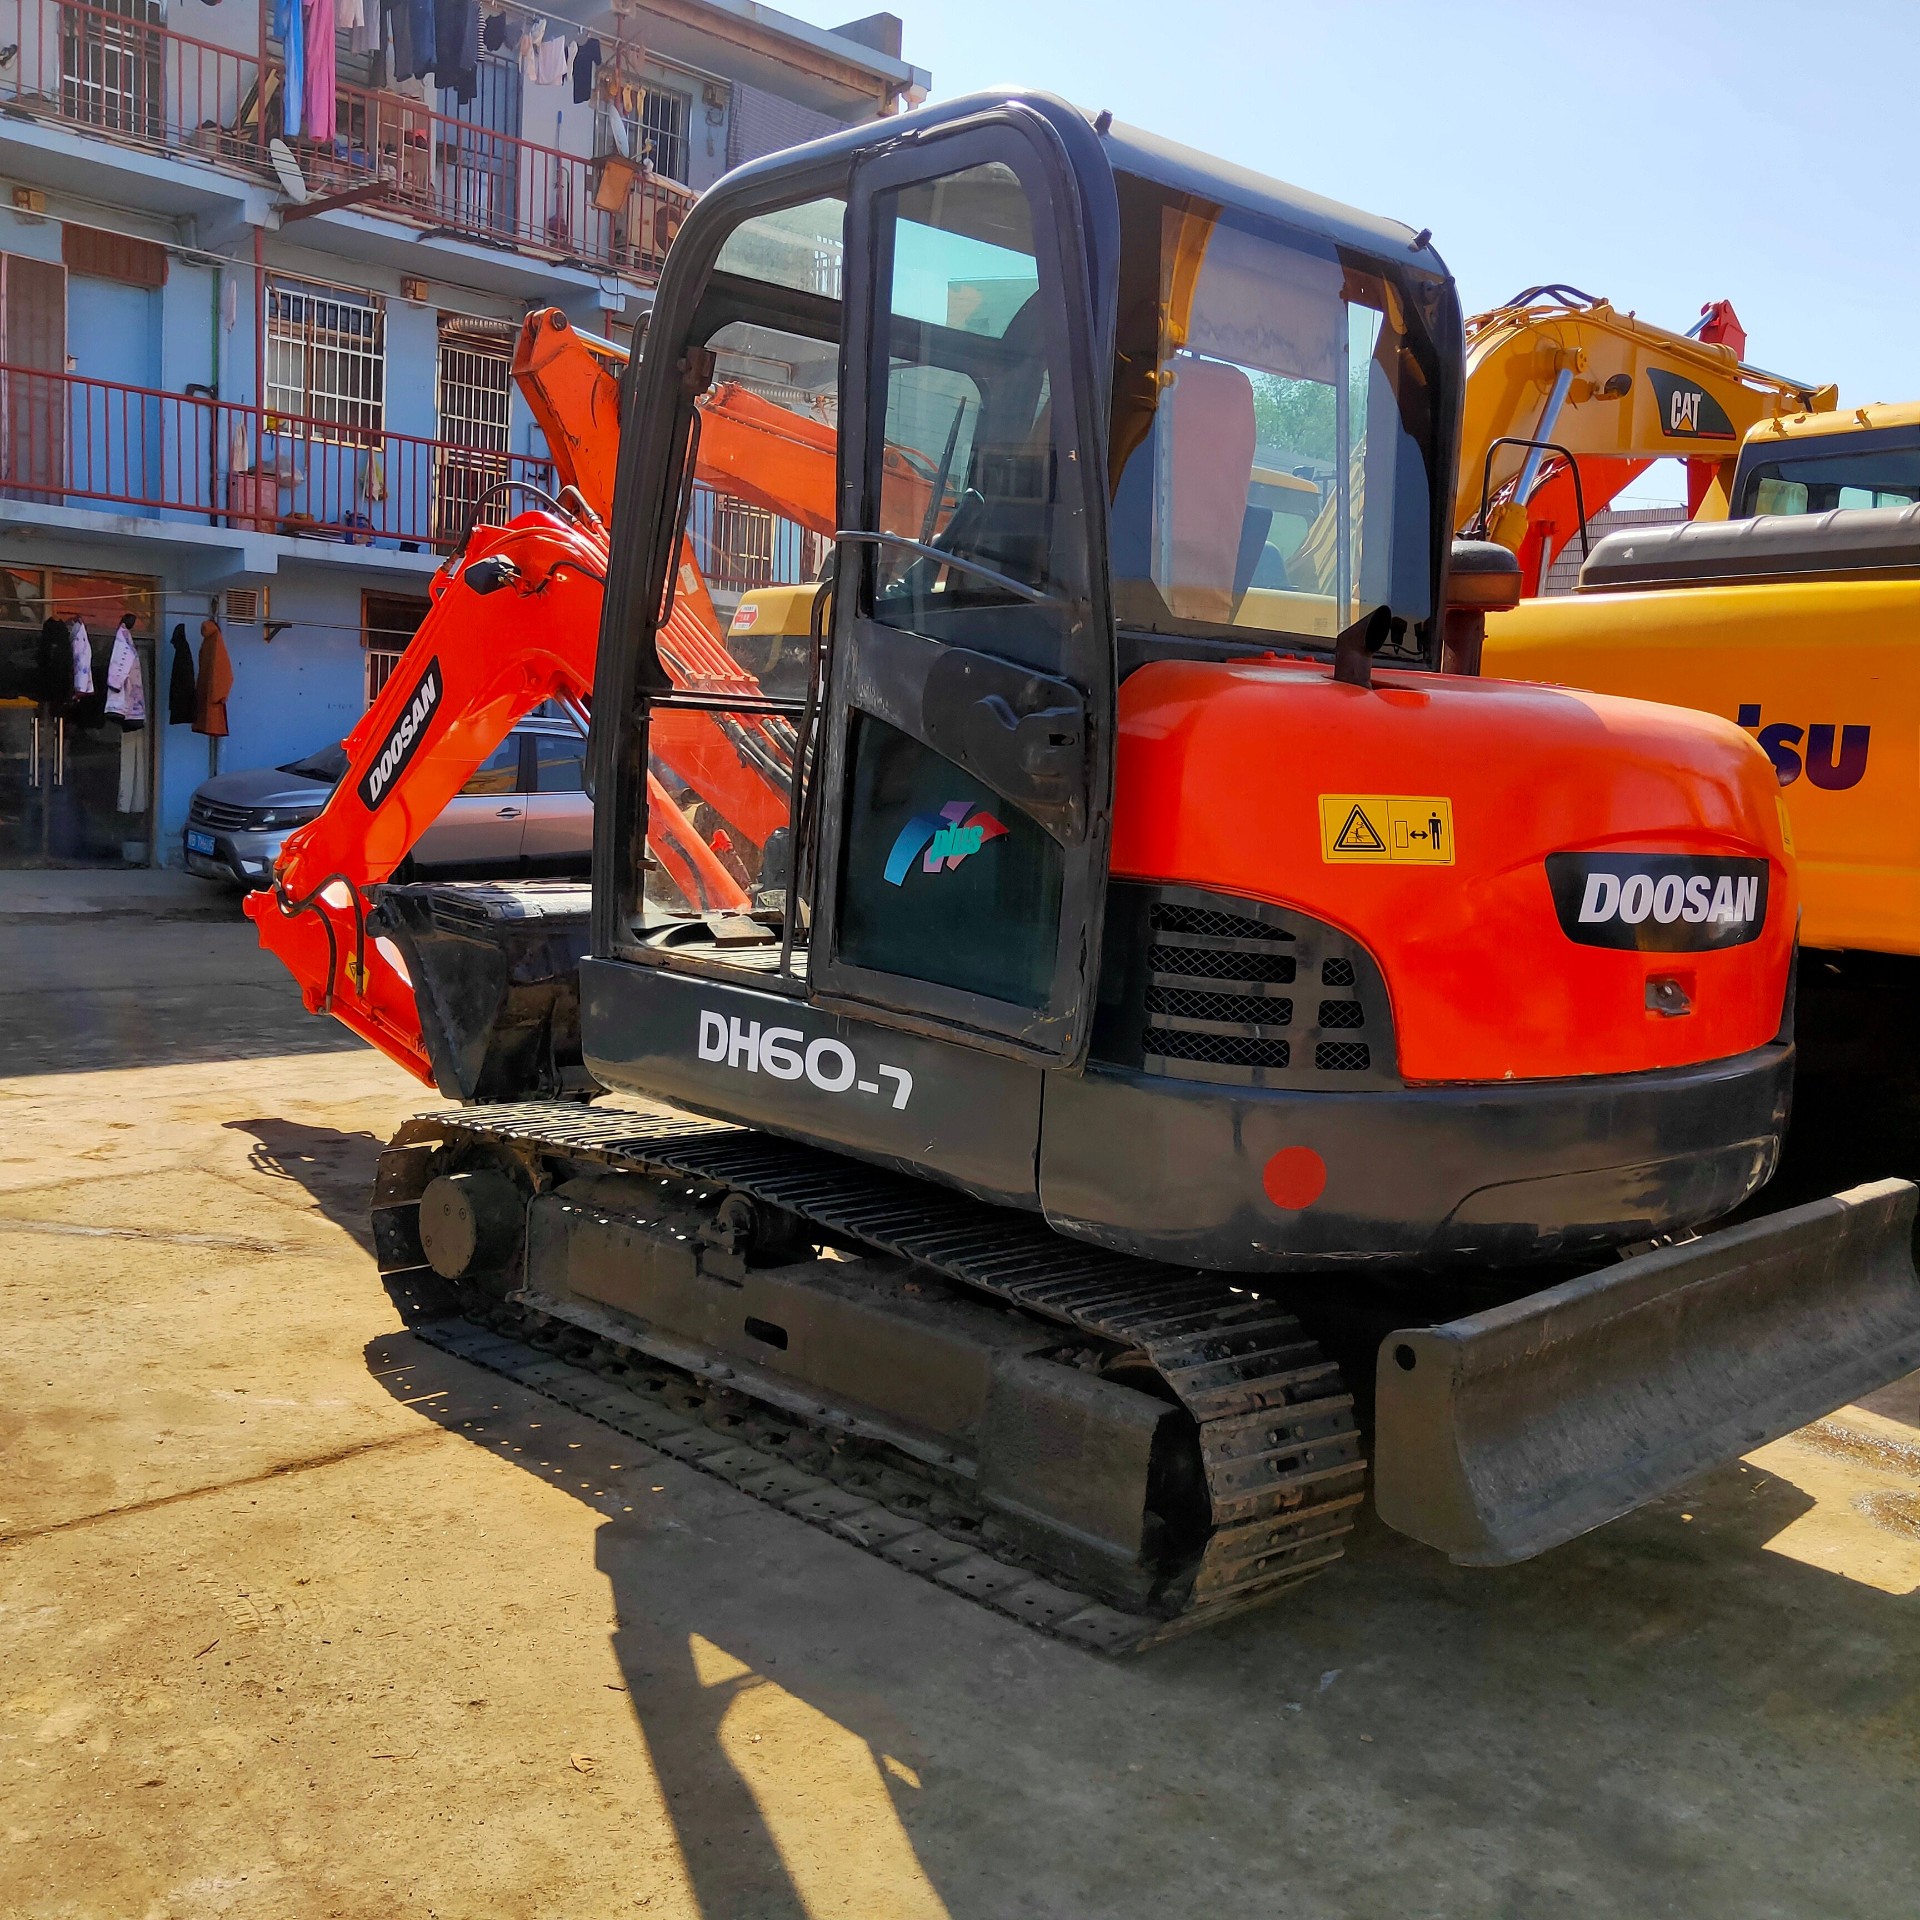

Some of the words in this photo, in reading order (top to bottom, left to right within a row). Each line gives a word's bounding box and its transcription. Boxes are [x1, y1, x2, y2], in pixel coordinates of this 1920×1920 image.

[1671, 391, 1701, 431] CAT
[369, 673, 436, 802] DOOSAN
[929, 822, 984, 863] plus
[1578, 873, 1758, 924] DOOSAN
[698, 1009, 913, 1110] DH60-7
